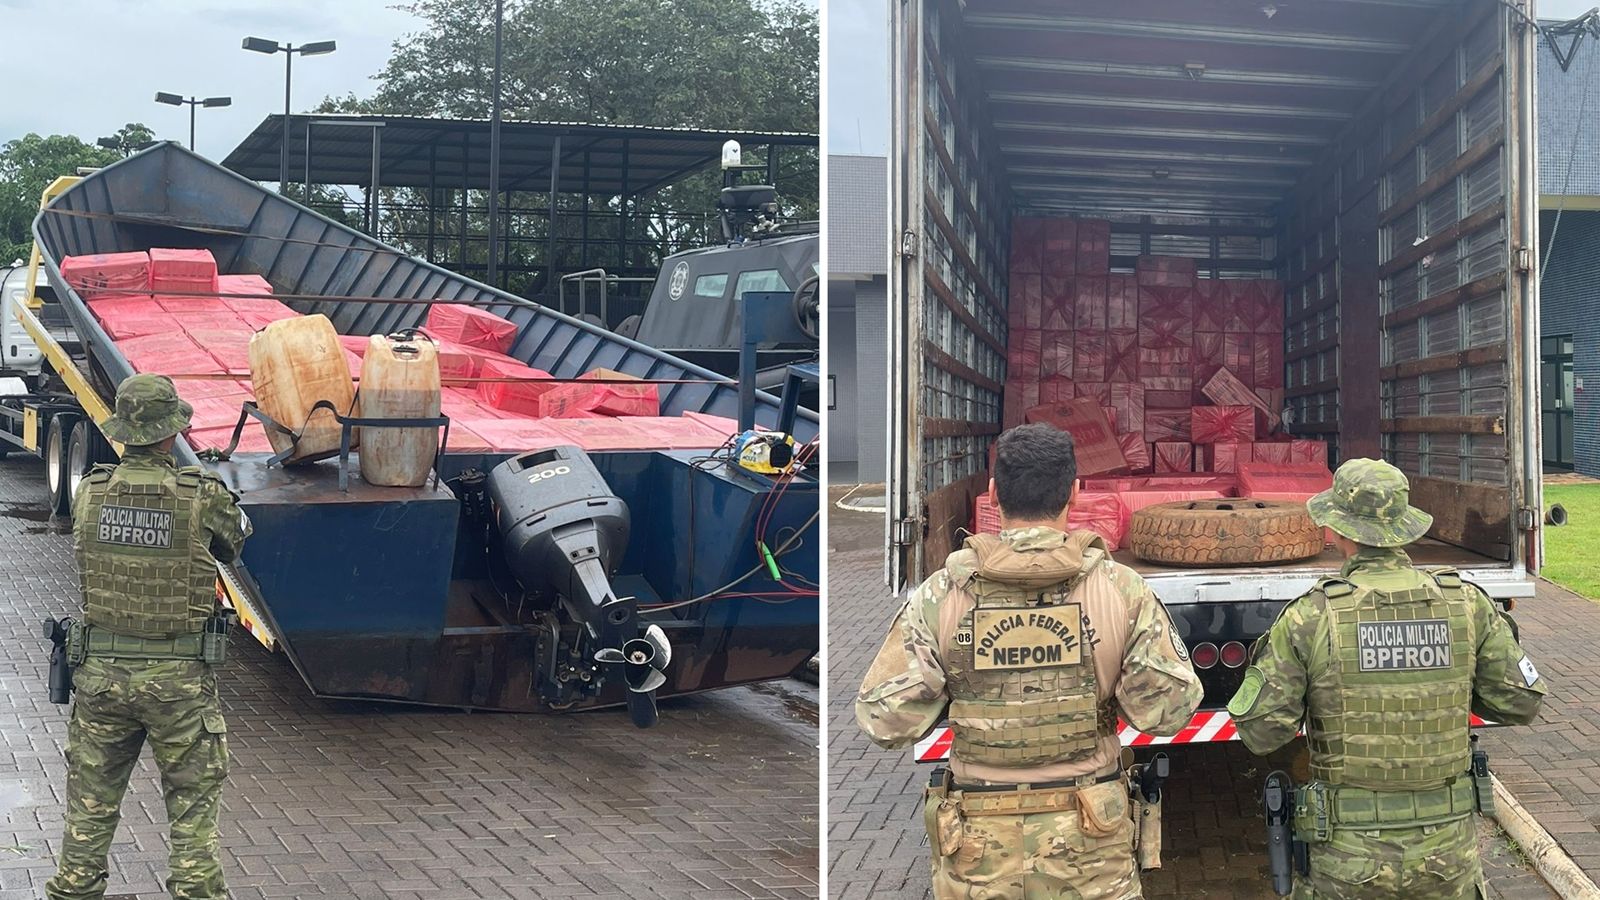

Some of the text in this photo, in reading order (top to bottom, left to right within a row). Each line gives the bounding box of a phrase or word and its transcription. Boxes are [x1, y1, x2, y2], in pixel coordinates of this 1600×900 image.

[528, 466, 570, 484] 200
[135, 511, 170, 530] MILITAR
[99, 524, 169, 546] BPFRON
[958, 632, 971, 643] 08
[1029, 613, 1079, 652] FEDERAL
[1405, 624, 1448, 645] MILITAR
[993, 644, 1062, 665] NEPOM
[1362, 645, 1450, 669] BPFRON
